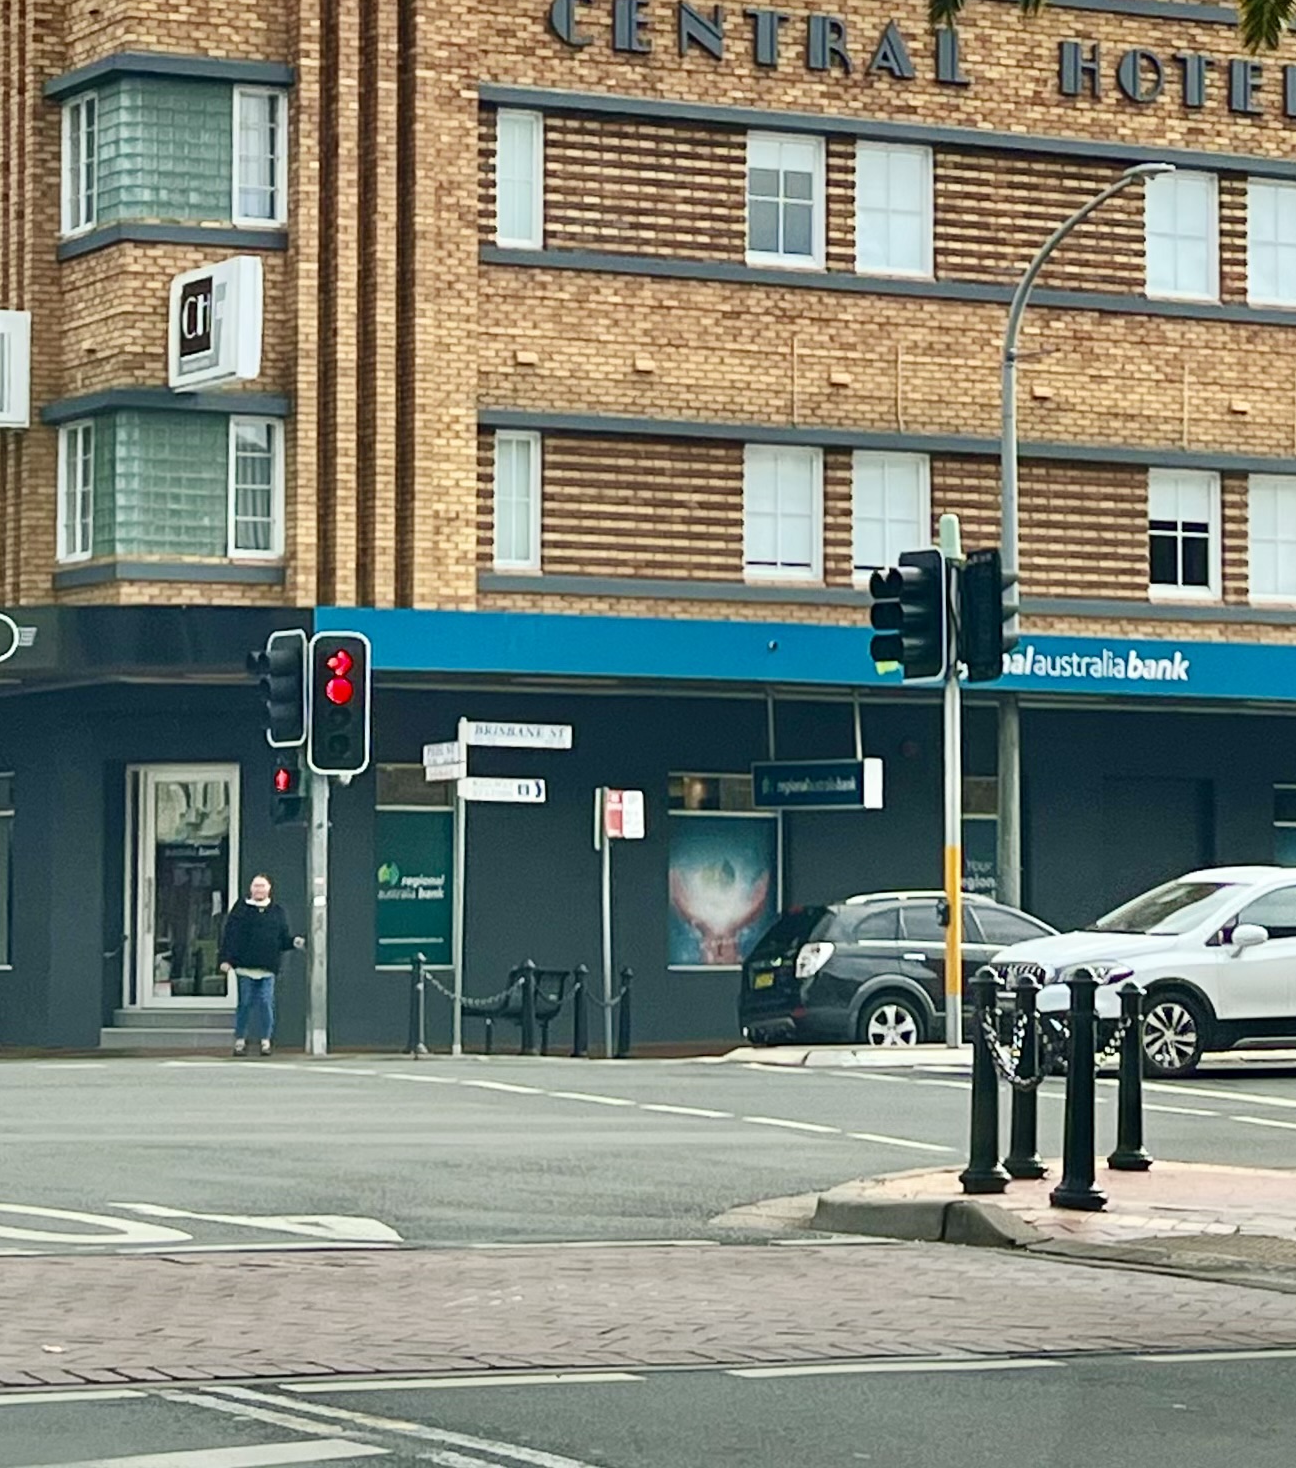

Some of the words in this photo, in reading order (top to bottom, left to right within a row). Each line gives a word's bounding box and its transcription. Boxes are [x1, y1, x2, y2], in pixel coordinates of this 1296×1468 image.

[182, 291, 211, 339] CH
[474, 723, 544, 738] BRISBANE
[417, 886, 445, 900] bank
